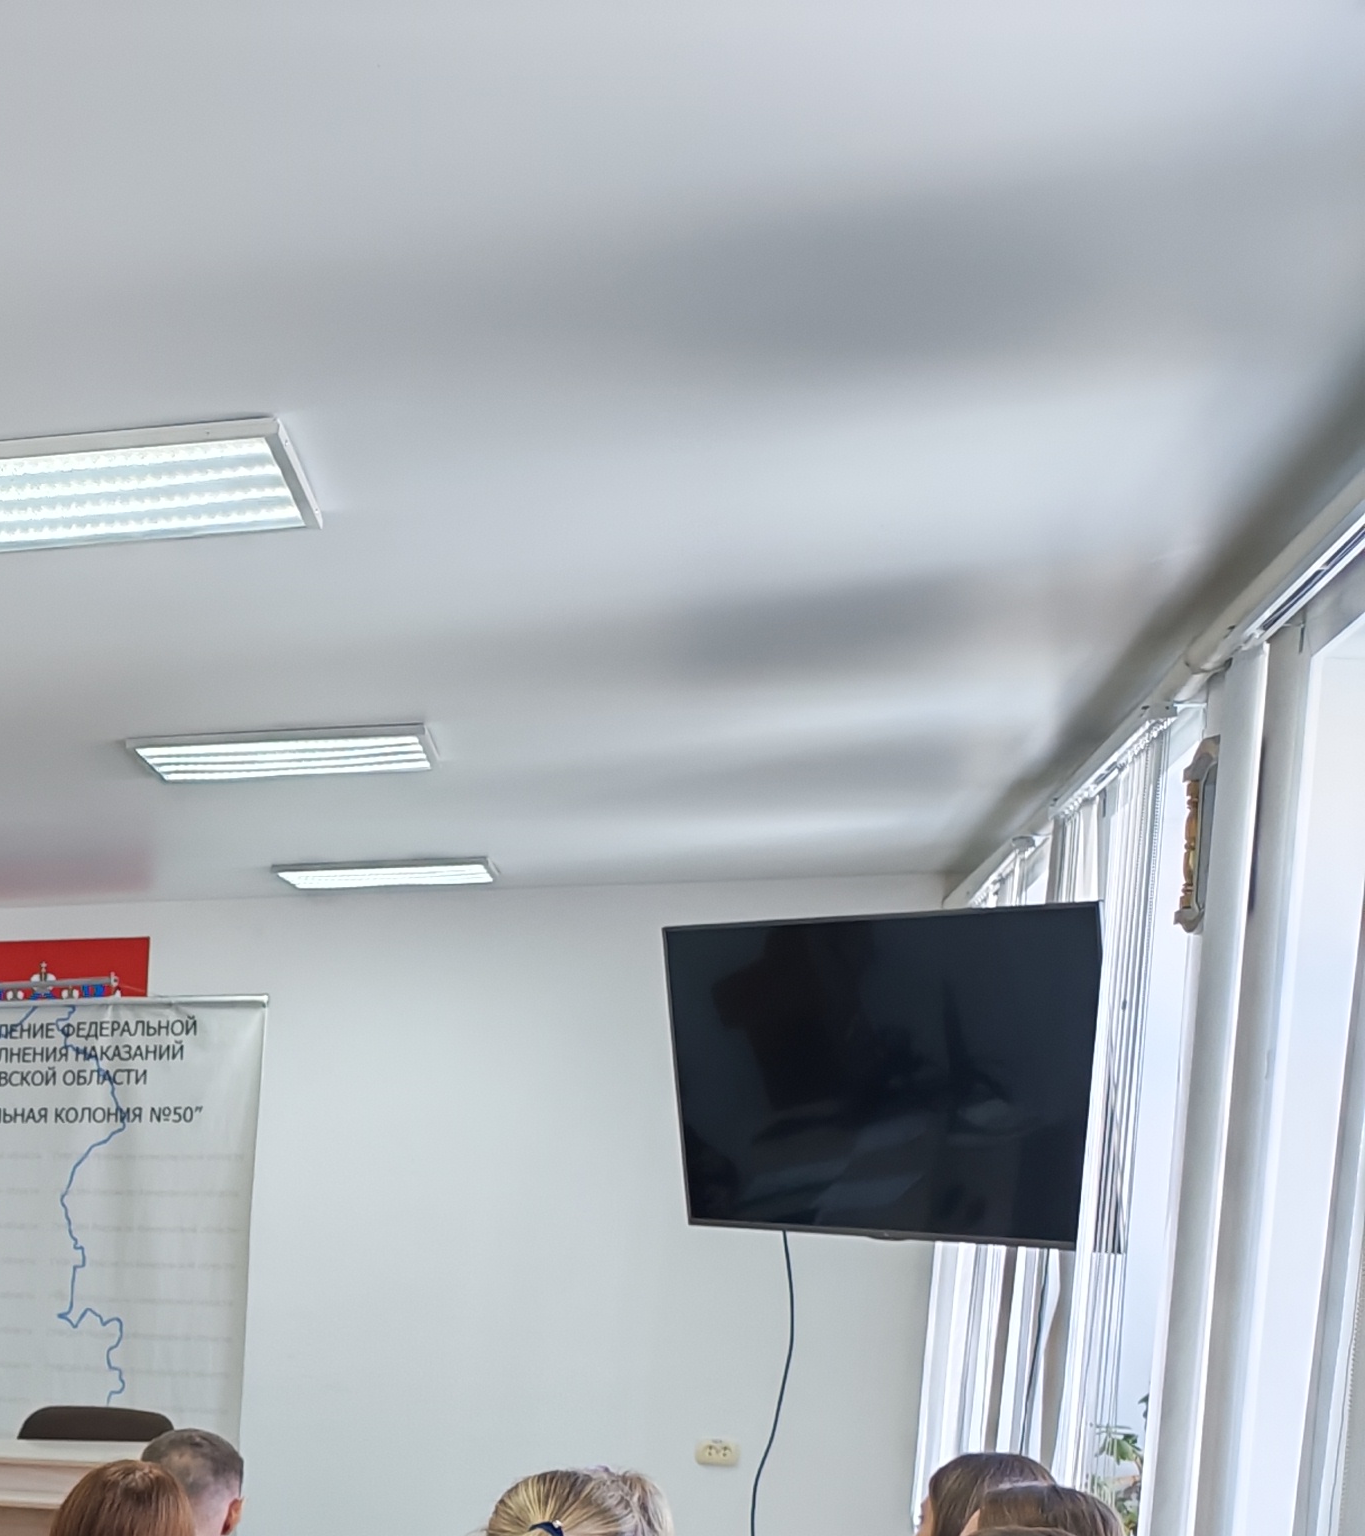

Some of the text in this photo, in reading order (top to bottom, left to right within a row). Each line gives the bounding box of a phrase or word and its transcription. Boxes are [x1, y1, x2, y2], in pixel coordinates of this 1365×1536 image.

[61, 1015, 198, 1040] ФЕДЕРАЛЬНОЙ
[75, 1040, 185, 1062] НАКАЗАНИЙ
[62, 1068, 148, 1086] ОБЛАСТИ
[54, 1106, 143, 1124] КОЛОНИЯ
